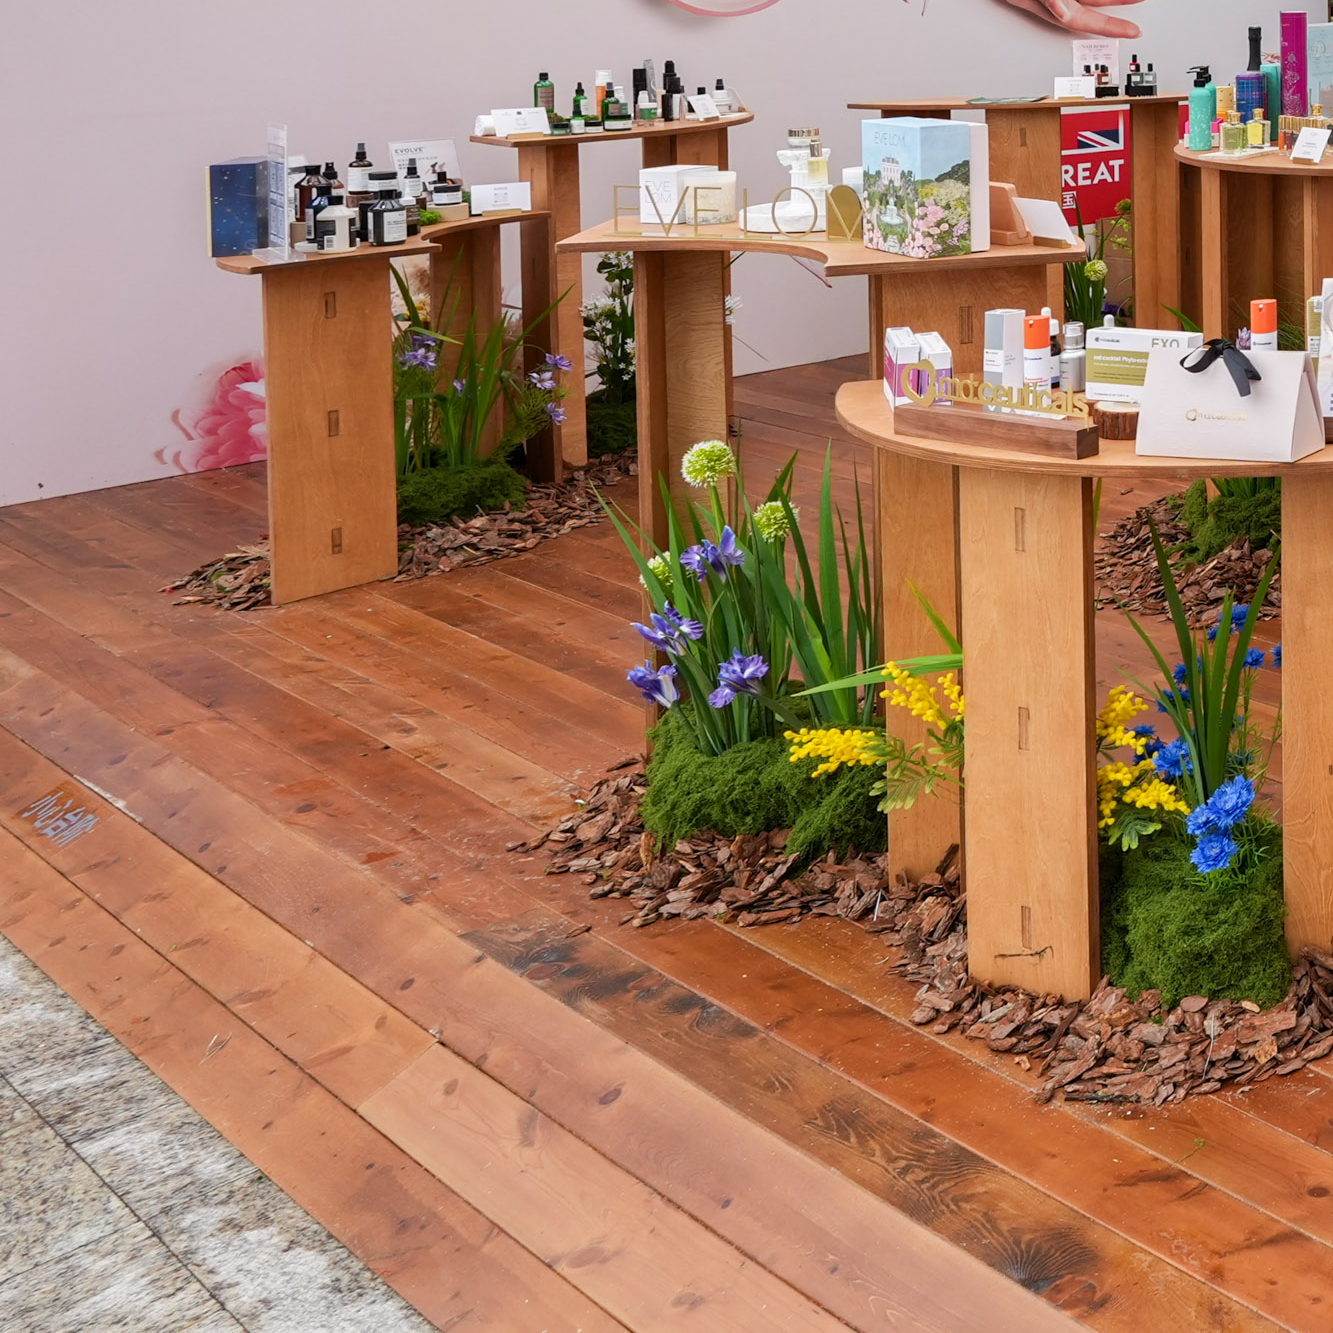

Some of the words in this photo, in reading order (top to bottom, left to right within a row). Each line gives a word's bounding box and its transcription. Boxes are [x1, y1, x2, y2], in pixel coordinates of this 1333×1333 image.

[874, 131, 889, 146] EVE
[890, 132, 906, 147] LOM
[1062, 159, 1125, 188] REAT
[613, 185, 722, 236] EVE
[1062, 190, 1077, 209] 国
